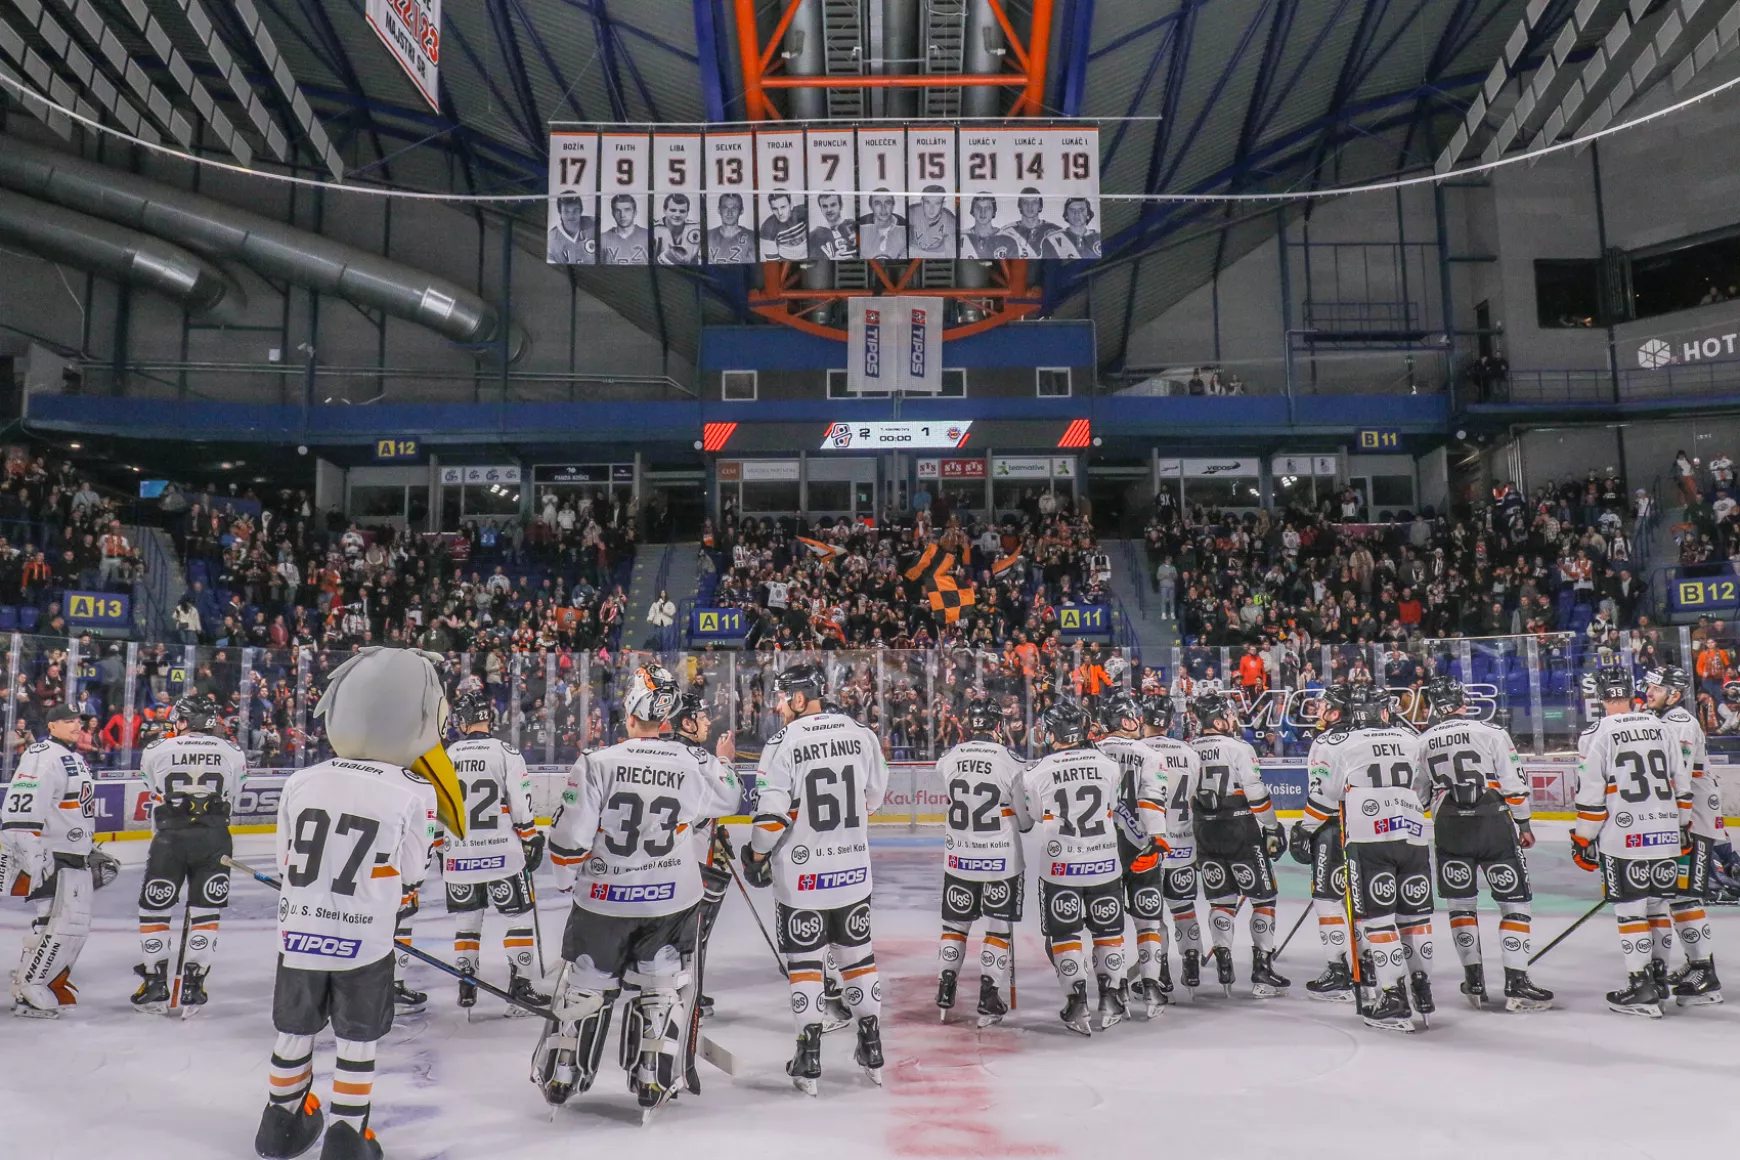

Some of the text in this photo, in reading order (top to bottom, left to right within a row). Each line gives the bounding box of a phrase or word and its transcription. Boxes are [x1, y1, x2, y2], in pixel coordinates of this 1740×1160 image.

[386, 10, 426, 80] MAJSTRI SR
[615, 144, 636, 152] FAITH
[716, 143, 742, 152] SELVEK
[767, 140, 794, 149] TROJÁK
[865, 137, 897, 146] HOLEČEK
[916, 137, 946, 146] KOLLÁTH
[969, 137, 990, 146] LUKÁČ
[1015, 137, 1036, 146] LUKÁČ
[1062, 137, 1082, 146] LUKÁČ
[558, 157, 588, 186] 17
[616, 158, 634, 186] 9
[668, 158, 686, 186] 5
[715, 157, 744, 186] 13
[772, 156, 790, 184] 9
[820, 154, 840, 182] 7
[877, 153, 886, 180] 1
[918, 152, 946, 180] 15
[969, 152, 998, 180] 21
[1014, 152, 1044, 180] 14
[1061, 152, 1090, 180] 19
[866, 328, 879, 378] TIPOS
[912, 328, 925, 378] TIPOS
[1684, 334, 1737, 362] HOT
[921, 427, 930, 436] 1
[1364, 432, 1397, 446] B 11
[381, 441, 416, 456] A 12
[1683, 582, 1735, 602] B 12
[96, 599, 122, 617] 13
[722, 614, 739, 630] 11
[1083, 610, 1100, 627] 11
[1609, 688, 1623, 697] 39
[478, 710, 489, 720] 22
[973, 718, 984, 727] 62
[1153, 718, 1164, 726] 24
[812, 723, 845, 732] BAUER
[1428, 732, 1470, 750] GILDON
[1612, 728, 1662, 746] POLLOCK
[635, 748, 678, 757] BAUER
[793, 739, 862, 764] BARTÁNUS
[1372, 744, 1405, 757] DEYL
[172, 753, 222, 766] LAMPER
[454, 759, 486, 772] MITRO
[957, 760, 992, 775] TEVES
[1167, 756, 1188, 769] RILA
[339, 762, 384, 776] BAUER
[1052, 767, 1102, 785] MARTEL
[1427, 750, 1485, 793] 56
[1615, 750, 1673, 803] 39
[616, 765, 686, 790] RIEČICKÝ
[884, 788, 950, 805] Kauflan
[1266, 783, 1302, 795] Košice
[8, 794, 34, 813] 32
[806, 764, 860, 832] 61
[949, 778, 1001, 832] 62
[1054, 785, 1106, 838] 12
[604, 792, 682, 858] 33
[1618, 815, 1631, 825] USS
[470, 838, 486, 847] Steel
[488, 837, 508, 845] Košice
[288, 808, 380, 896] 97
[794, 850, 808, 860] USS
[1171, 848, 1192, 858] POS
[458, 857, 502, 870] TIPOS
[960, 859, 1002, 870] TIPOS
[1069, 862, 1114, 874] TIPOS
[1253, 845, 1272, 891] MORIS
[1316, 844, 1328, 892] MORIS
[1693, 841, 1706, 892] MORIS
[820, 869, 866, 887] TIPOS
[1174, 872, 1193, 886] USS
[1204, 867, 1222, 882] USS
[1446, 867, 1470, 882] USS
[1490, 872, 1514, 887] USS
[1632, 866, 1650, 882] USS
[1656, 866, 1676, 880] USS
[149, 886, 172, 900] USS
[208, 882, 228, 896] USS
[489, 884, 508, 898] USS
[612, 885, 672, 900] TIPOS
[984, 884, 1006, 900] USS
[1349, 858, 1362, 913] MORIS
[1375, 878, 1396, 898] USS
[1405, 880, 1427, 897] USS
[950, 890, 971, 906] USS
[1138, 894, 1159, 910] USS
[291, 904, 373, 924] U. S. Steel Košice
[1055, 899, 1078, 916] USS
[1094, 903, 1116, 918] USS
[792, 917, 820, 938] USS
[851, 914, 870, 932] USS
[1684, 931, 1698, 940] USS
[286, 933, 356, 956] TIPOS
[1505, 940, 1519, 948] USS
[25, 934, 52, 983] VAUGHN
[39, 942, 61, 980] VAUGHN
[1107, 958, 1121, 967] USS
